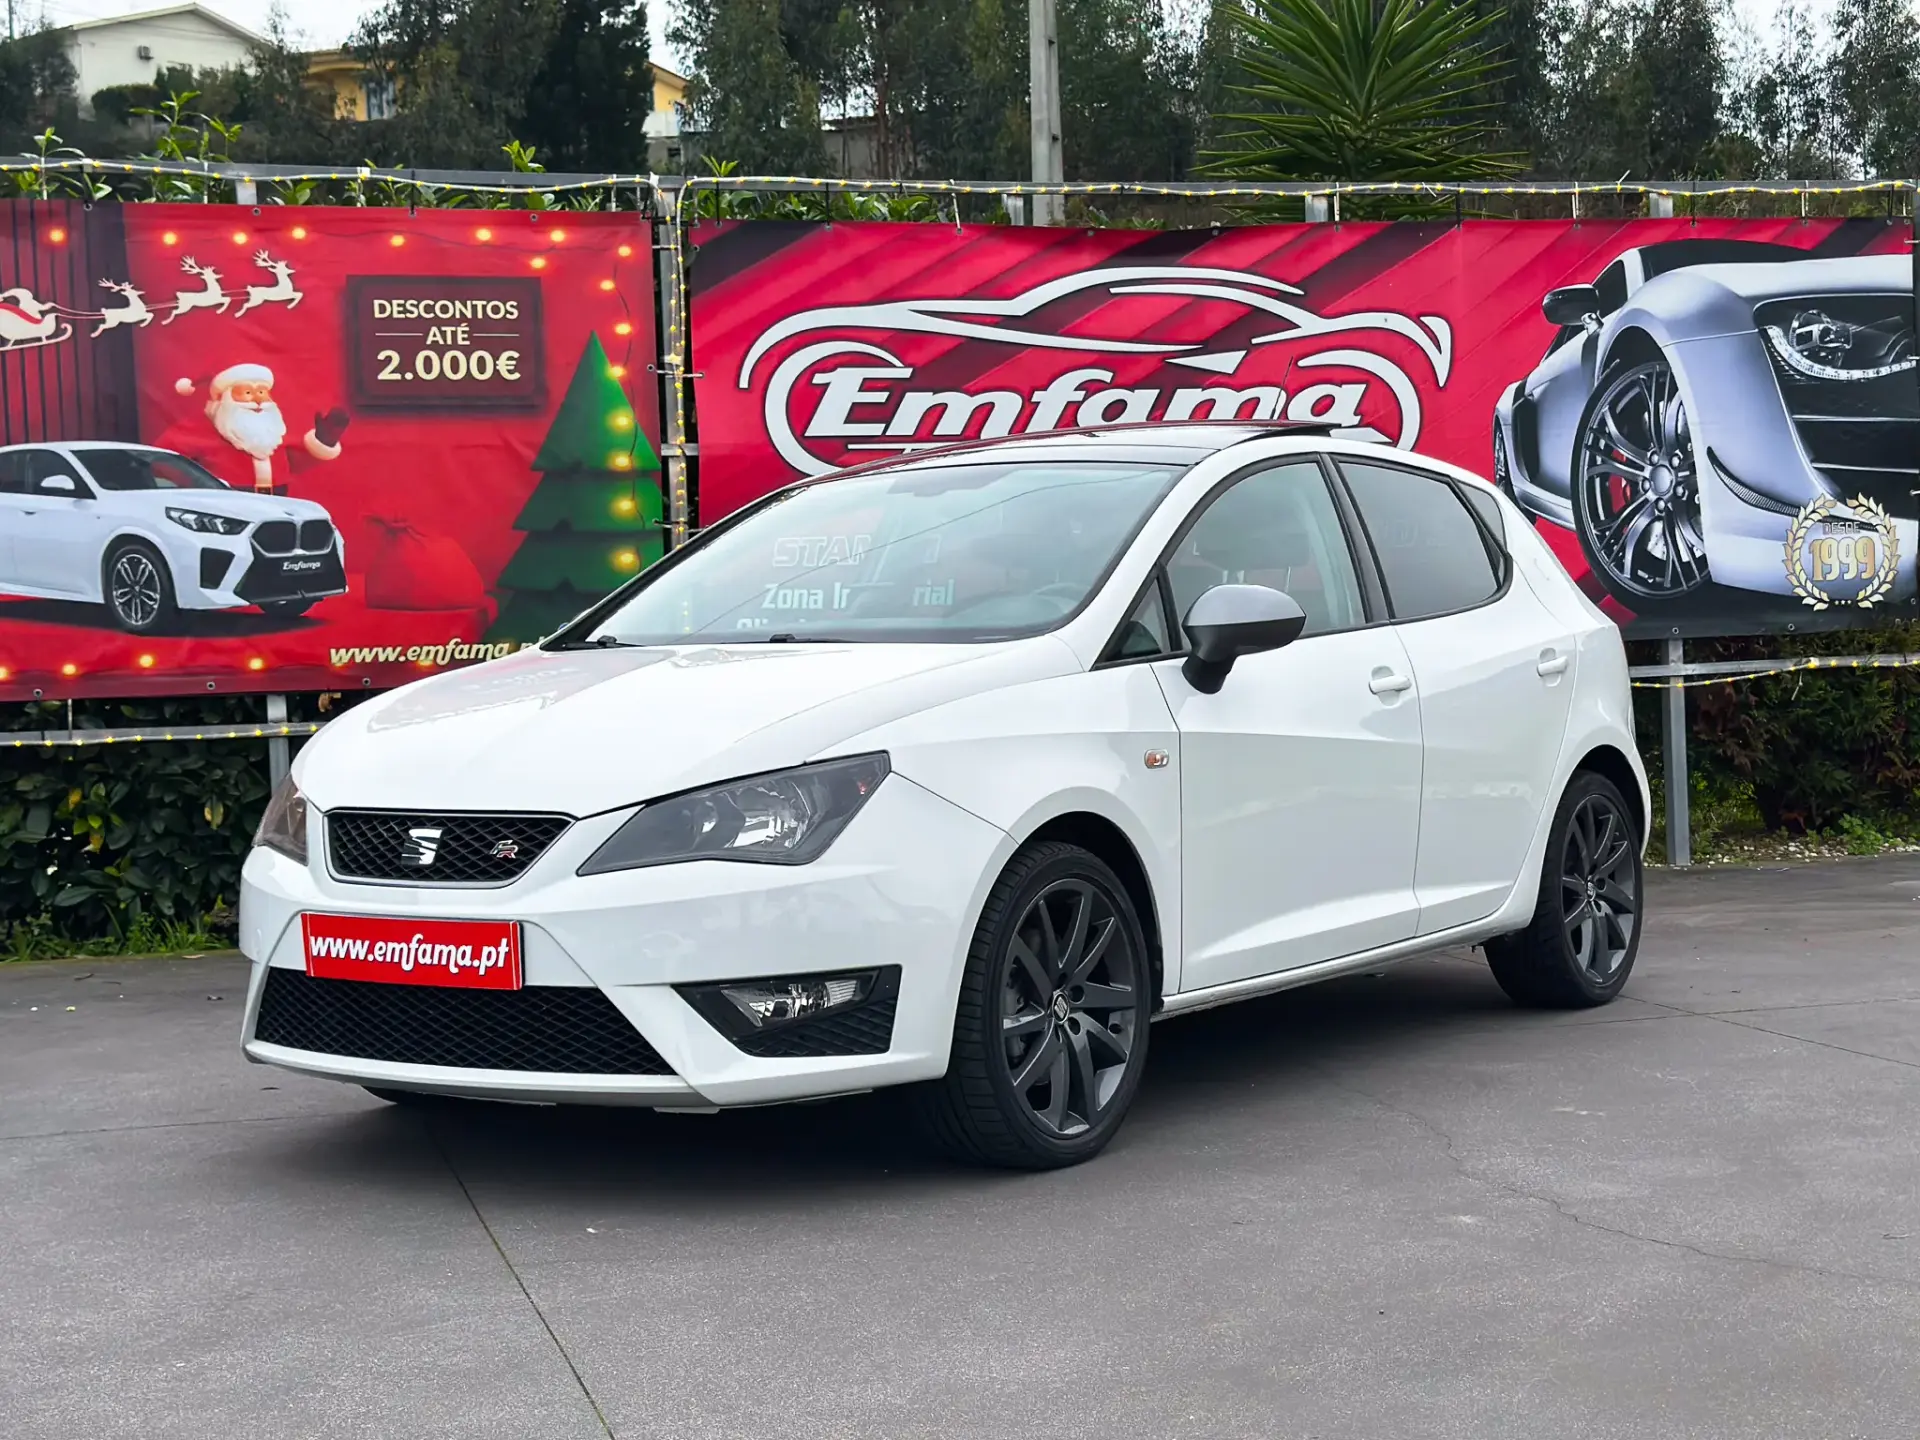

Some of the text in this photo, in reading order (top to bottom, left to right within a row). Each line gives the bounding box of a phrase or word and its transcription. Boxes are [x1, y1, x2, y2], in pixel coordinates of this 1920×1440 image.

[373, 299, 519, 320] DESCONTOS
[425, 322, 471, 345] ATÉ
[377, 349, 521, 381] 2.000€
[804, 369, 1367, 437] Emfama
[1822, 521, 1861, 535] DESDE
[282, 560, 321, 571] Emfama
[1808, 536, 1876, 582] 1999
[761, 583, 823, 610] Zona
[310, 933, 509, 975] www.emfama.pt
